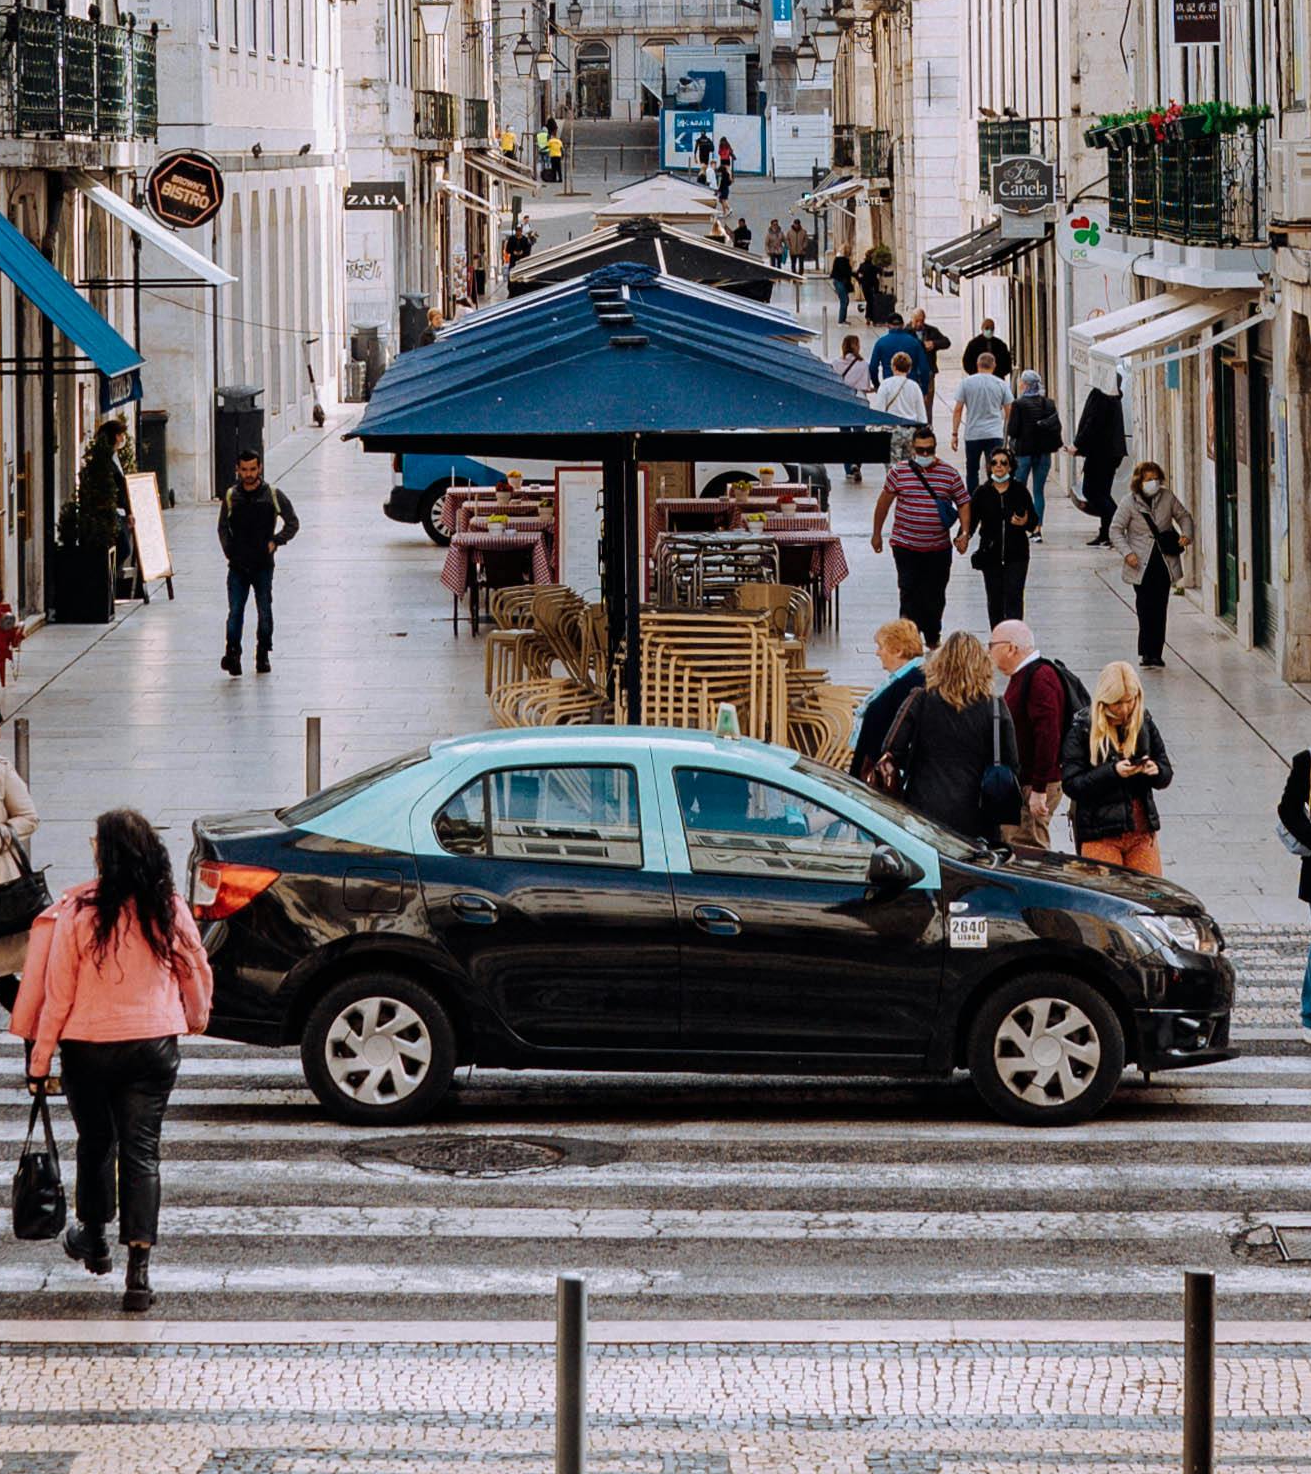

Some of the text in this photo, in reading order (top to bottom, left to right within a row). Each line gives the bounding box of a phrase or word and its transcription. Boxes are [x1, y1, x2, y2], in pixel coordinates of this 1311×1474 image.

[998, 180, 1048, 197] Canela
[160, 183, 210, 210] BISTRO
[346, 194, 399, 206] ZARA
[952, 920, 986, 933] 2640
